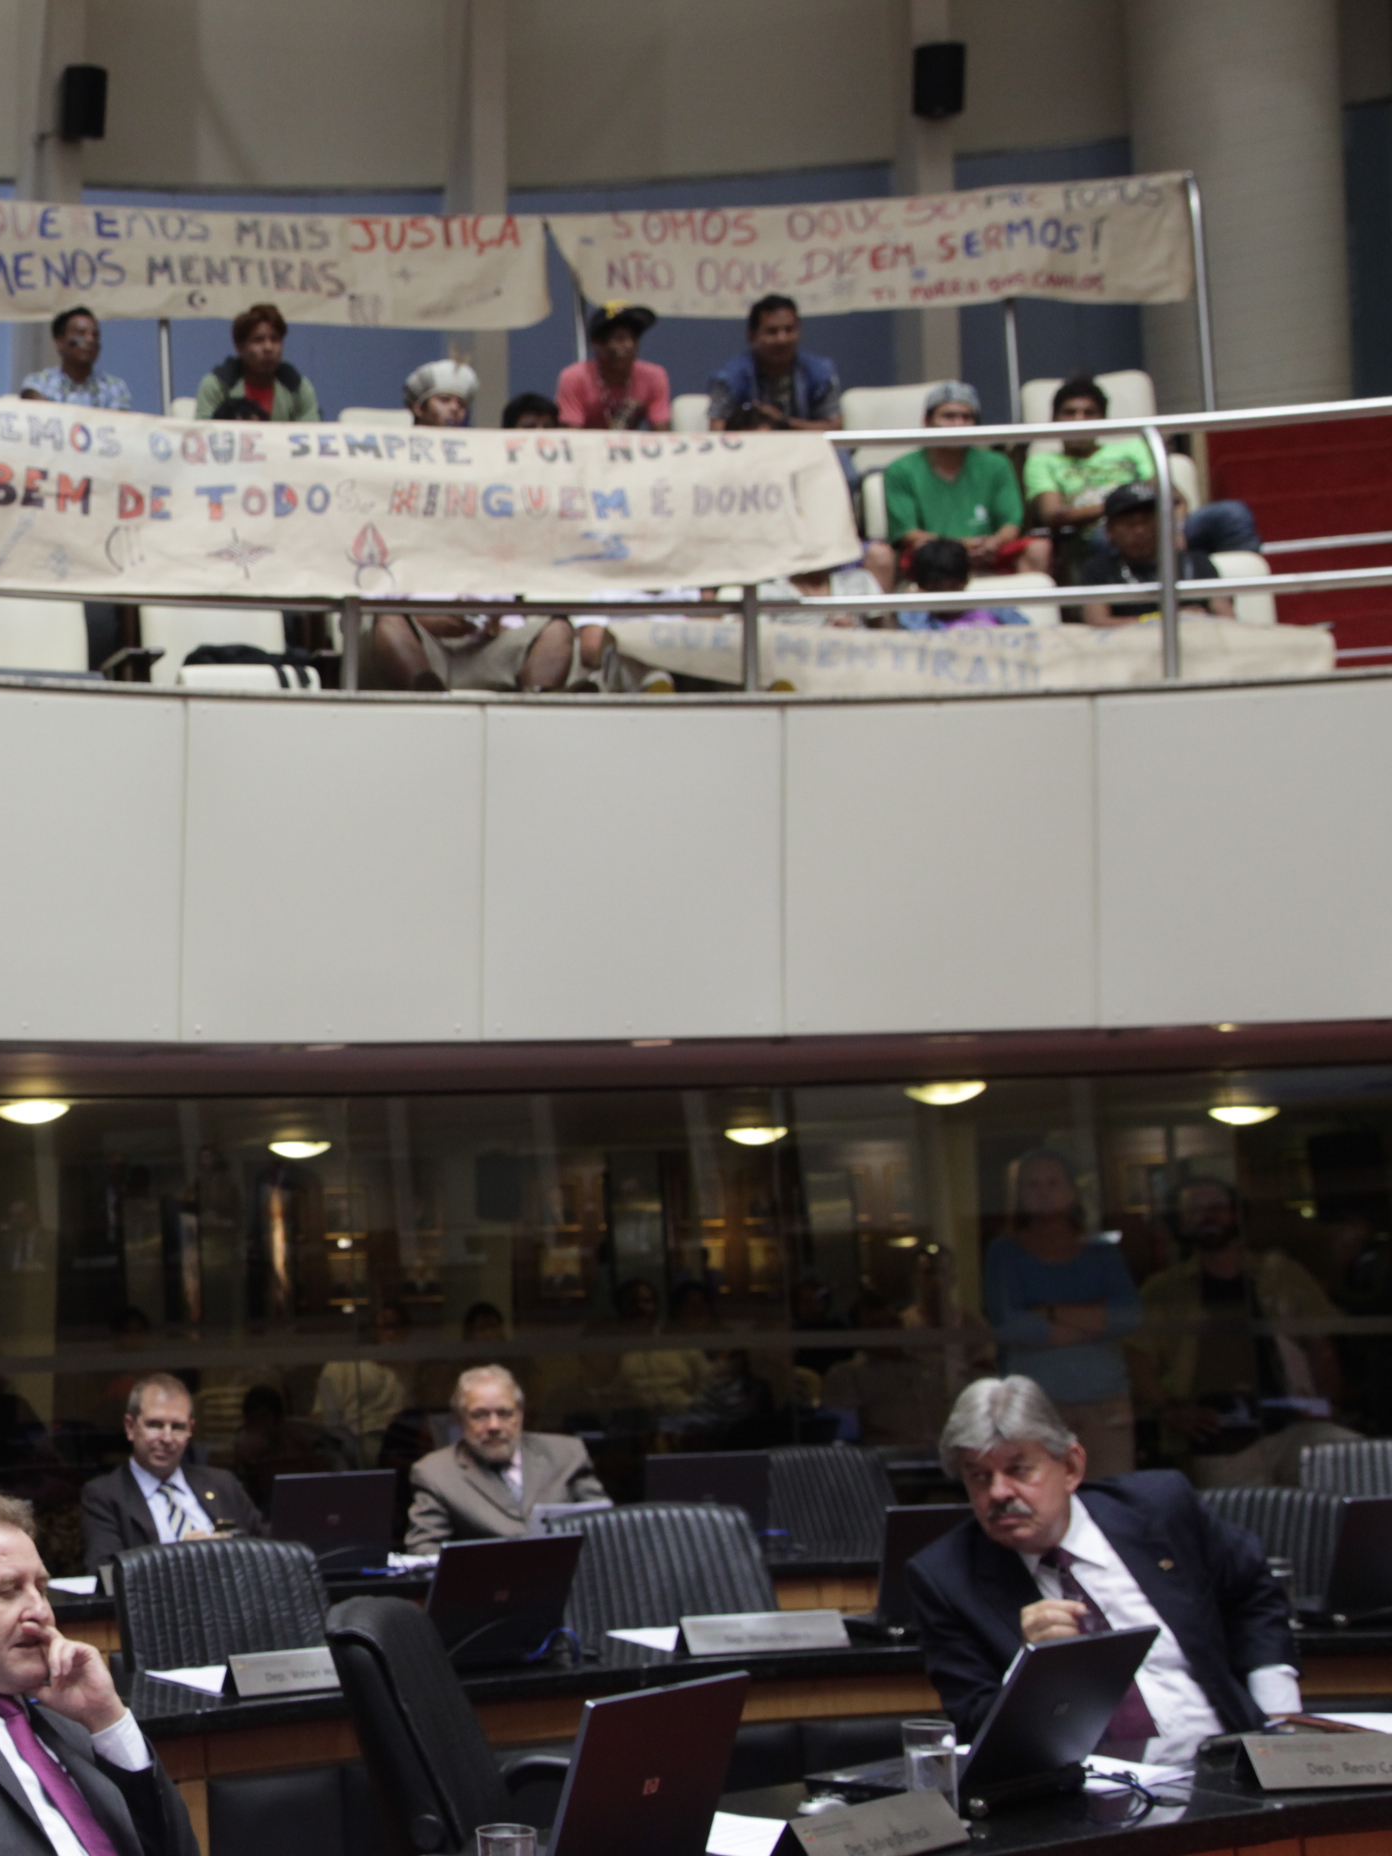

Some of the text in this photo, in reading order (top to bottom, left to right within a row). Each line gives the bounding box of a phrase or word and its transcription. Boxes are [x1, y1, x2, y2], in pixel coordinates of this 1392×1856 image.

[234, 216, 332, 251] MAIS
[349, 213, 520, 257] JUSTIÇA
[611, 207, 759, 247] SOMOS
[605, 250, 676, 292] NÃO
[288, 432, 473, 466] SEMPRE
[504, 436, 574, 464] FOI
[117, 482, 172, 520] DE
